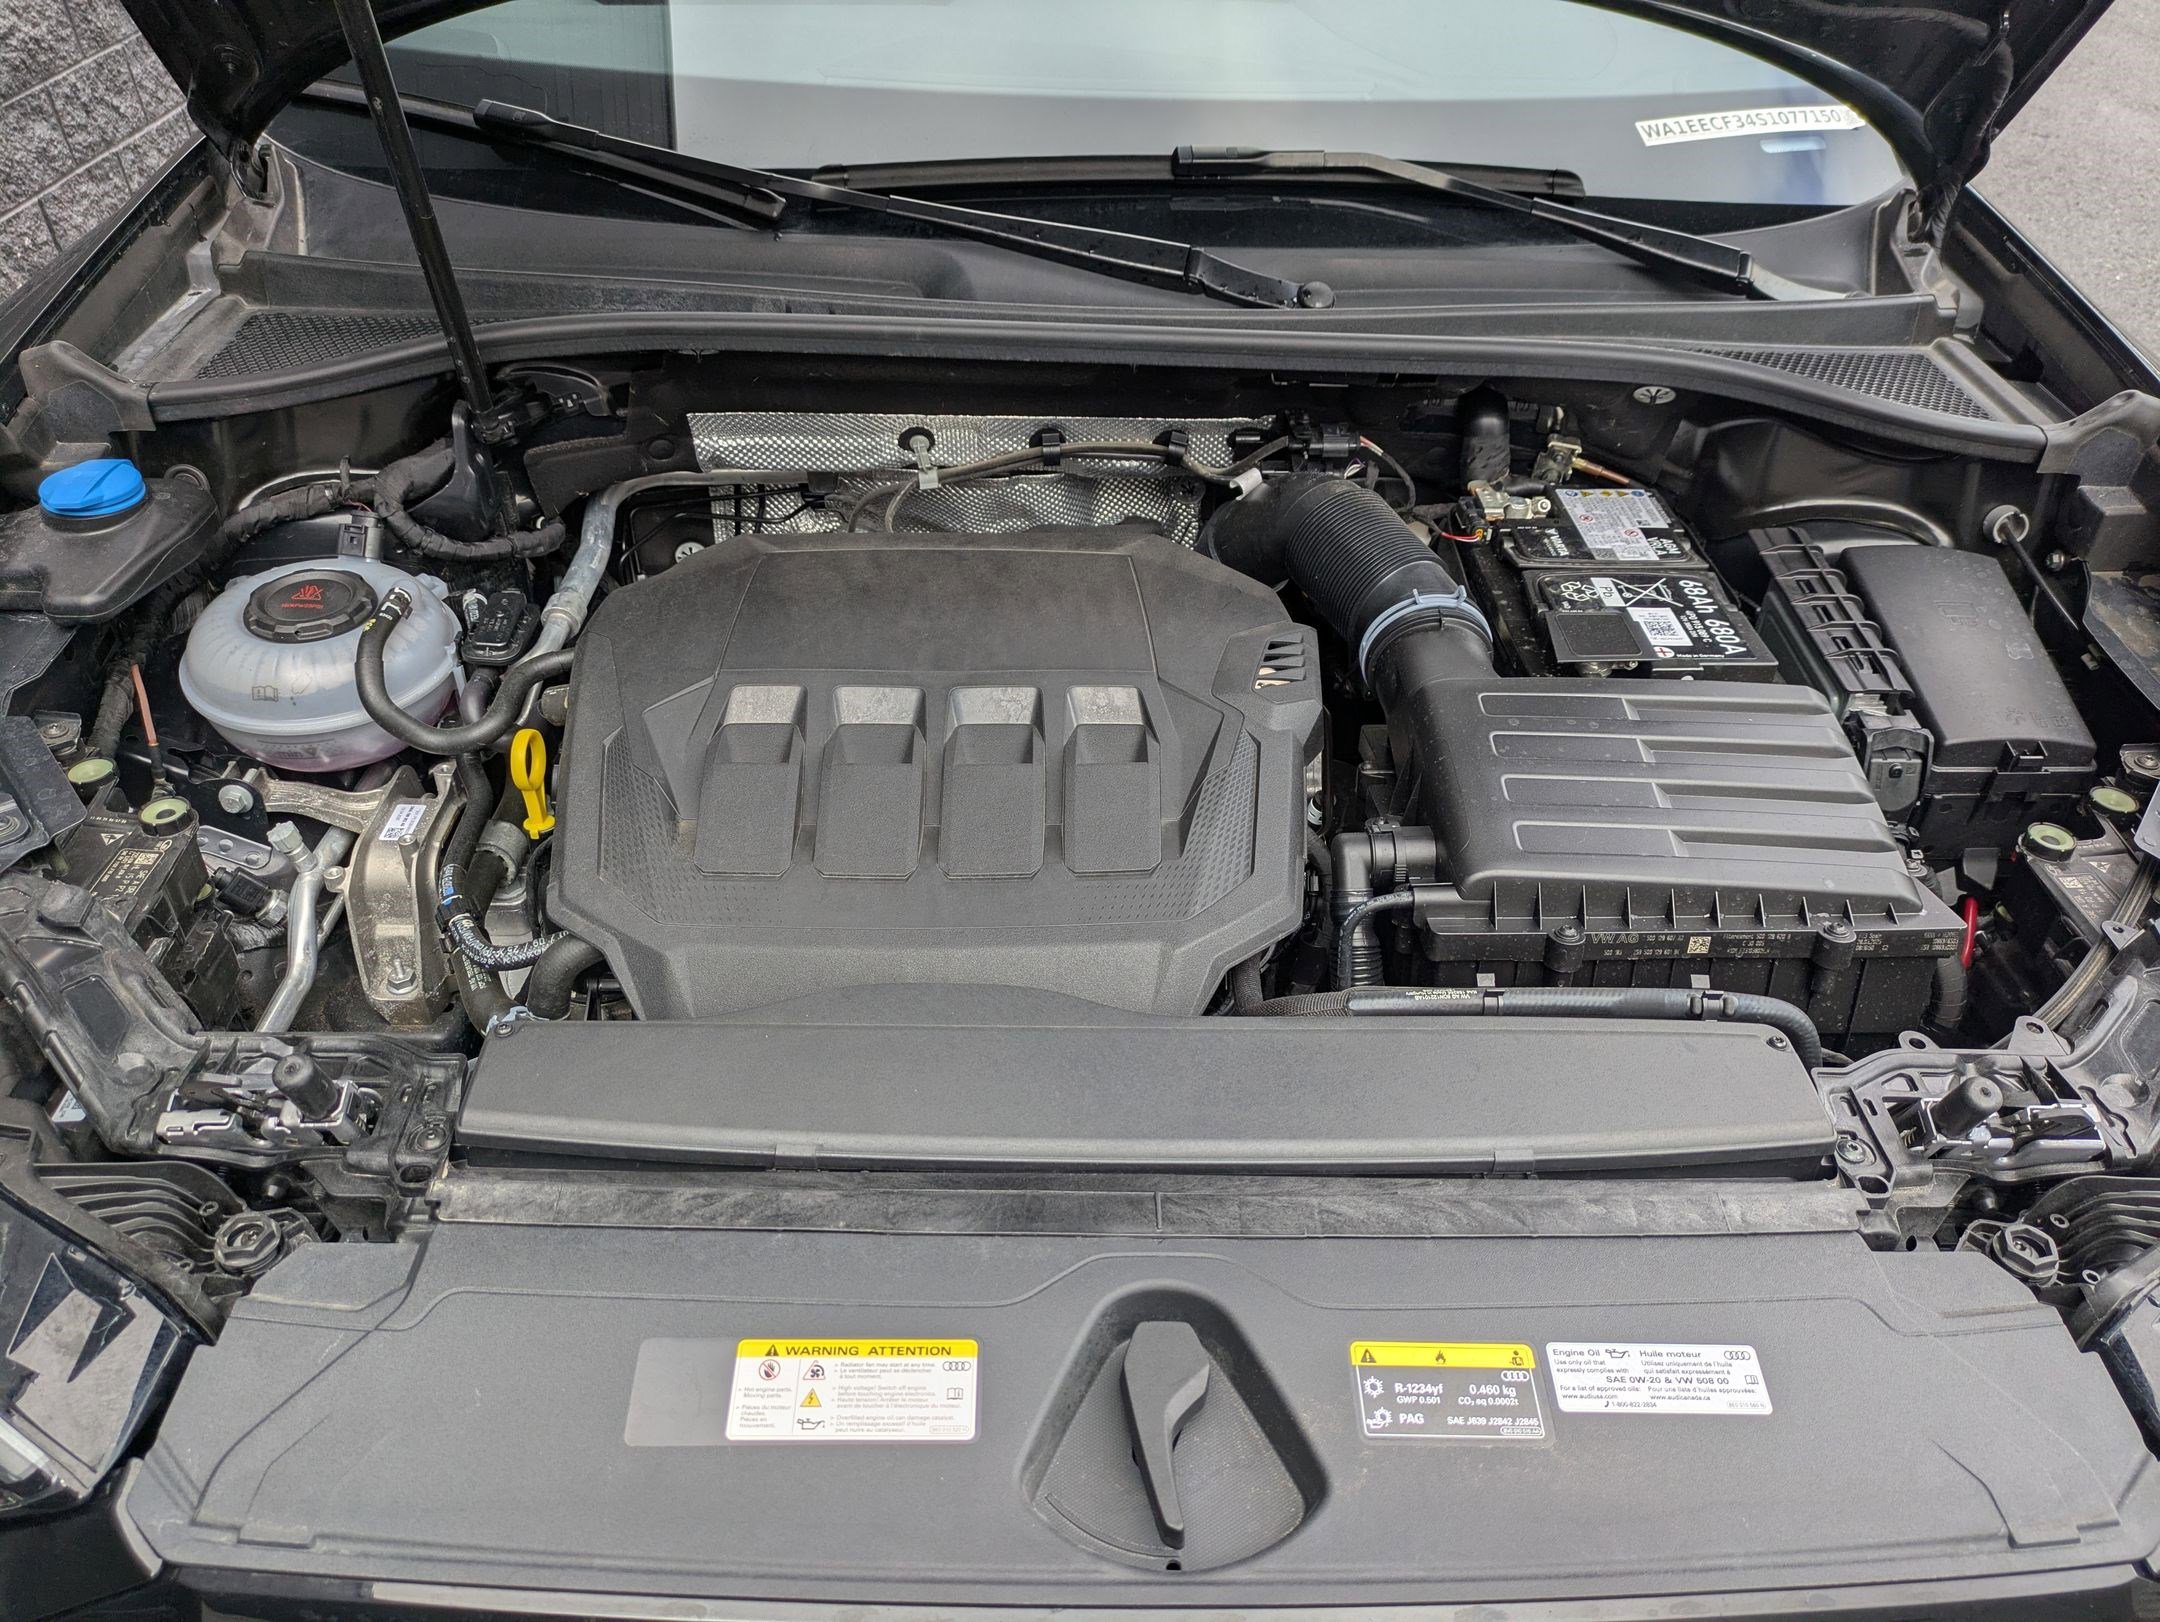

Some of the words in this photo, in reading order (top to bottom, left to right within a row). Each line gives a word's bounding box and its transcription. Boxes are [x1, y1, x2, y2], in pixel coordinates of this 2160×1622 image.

[1640, 109, 1842, 138] WA1EECF34S1077150
[1550, 534, 1569, 556] VARTA
[1647, 537, 1667, 555] VRLA
[1600, 586, 1613, 598] Pb
[1679, 580, 1718, 613] 68Ah
[1704, 619, 1747, 655] 680A
[1590, 933, 1616, 944] VW
[1616, 933, 1639, 944] AG
[786, 1346, 859, 1356] WARNING
[868, 1346, 952, 1356] ATTENTION
[1552, 1348, 1584, 1357] Engine
[1588, 1348, 1600, 1356] Oil
[1640, 1350, 1664, 1358] Huile
[1666, 1350, 1701, 1358] moteur
[1628, 1376, 1661, 1384] 0W-20
[1664, 1376, 1672, 1384] &
[1675, 1376, 1693, 1384] VW
[1394, 1383, 1443, 1396] R-1234yf
[1469, 1384, 1500, 1395] 0.460
[1502, 1385, 1516, 1398] kg
[1396, 1396, 1418, 1404] GWP
[1399, 1414, 1424, 1424] PAG
[1447, 1416, 1465, 1425] SAE
